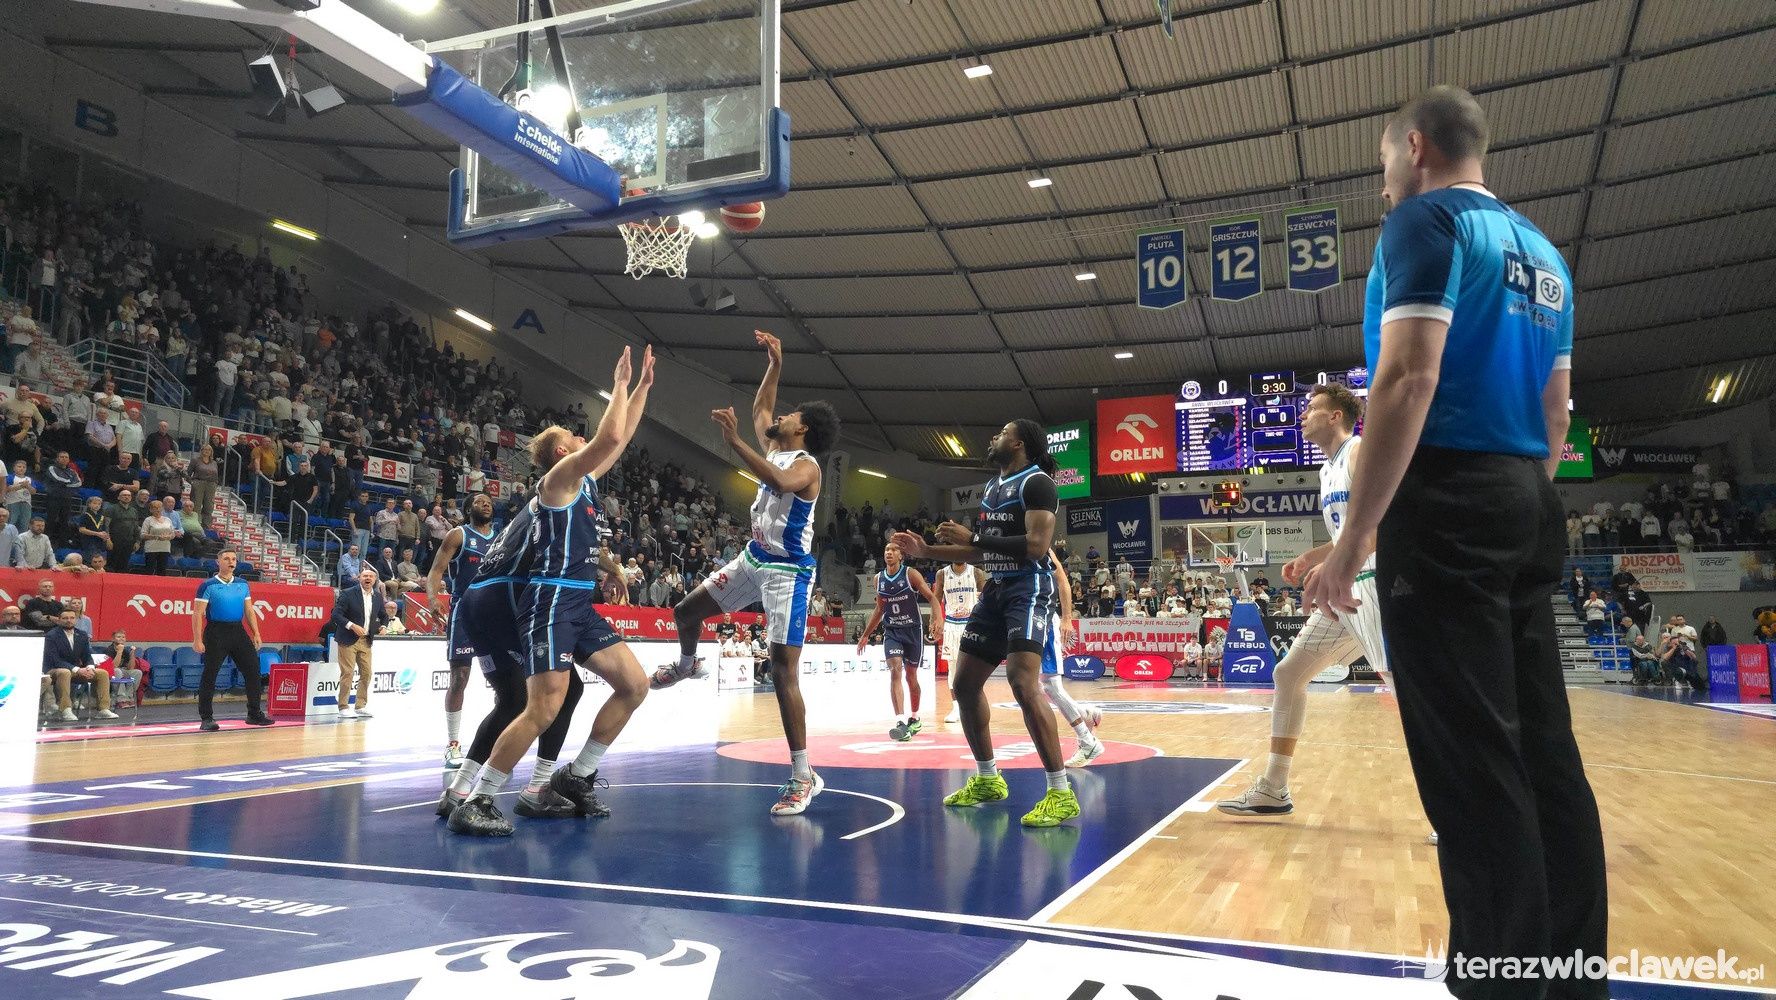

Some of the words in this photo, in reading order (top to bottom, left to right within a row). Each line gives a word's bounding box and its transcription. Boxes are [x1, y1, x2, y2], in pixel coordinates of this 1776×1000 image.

[75, 99, 118, 137] B
[518, 117, 562, 155] Schelde
[1288, 218, 1337, 232] SZEWCZYK
[1212, 229, 1259, 243] GRISZCZUK
[1147, 240, 1175, 251] PLUTA
[1290, 235, 1338, 273] 33
[1217, 245, 1256, 282] 12
[1142, 255, 1182, 290] 10
[512, 308, 547, 335] A
[1318, 372, 1327, 386] 0
[1219, 380, 1227, 395] 0
[1262, 382, 1286, 393] 9:30
[1259, 413, 1266, 424] 0
[1280, 411, 1287, 423] 0
[1046, 429, 1080, 445] ORLEN
[1109, 446, 1164, 462] ORLEN
[1051, 468, 1078, 478] UPONY
[1200, 493, 1322, 515] WOCŁAW
[1070, 510, 1102, 525] SELENKA
[1284, 526, 1304, 535] Bank
[1620, 554, 1685, 568] DUSZPOL
[958, 595, 964, 603] 5
[159, 599, 194, 615] ORL
[276, 604, 323, 620] ORLEN
[892, 603, 901, 615] 0
[615, 619, 639, 629] ORLEN
[1230, 663, 1259, 674] PGE
[433, 673, 450, 690] ENB
[163, 891, 348, 917] Miasto
